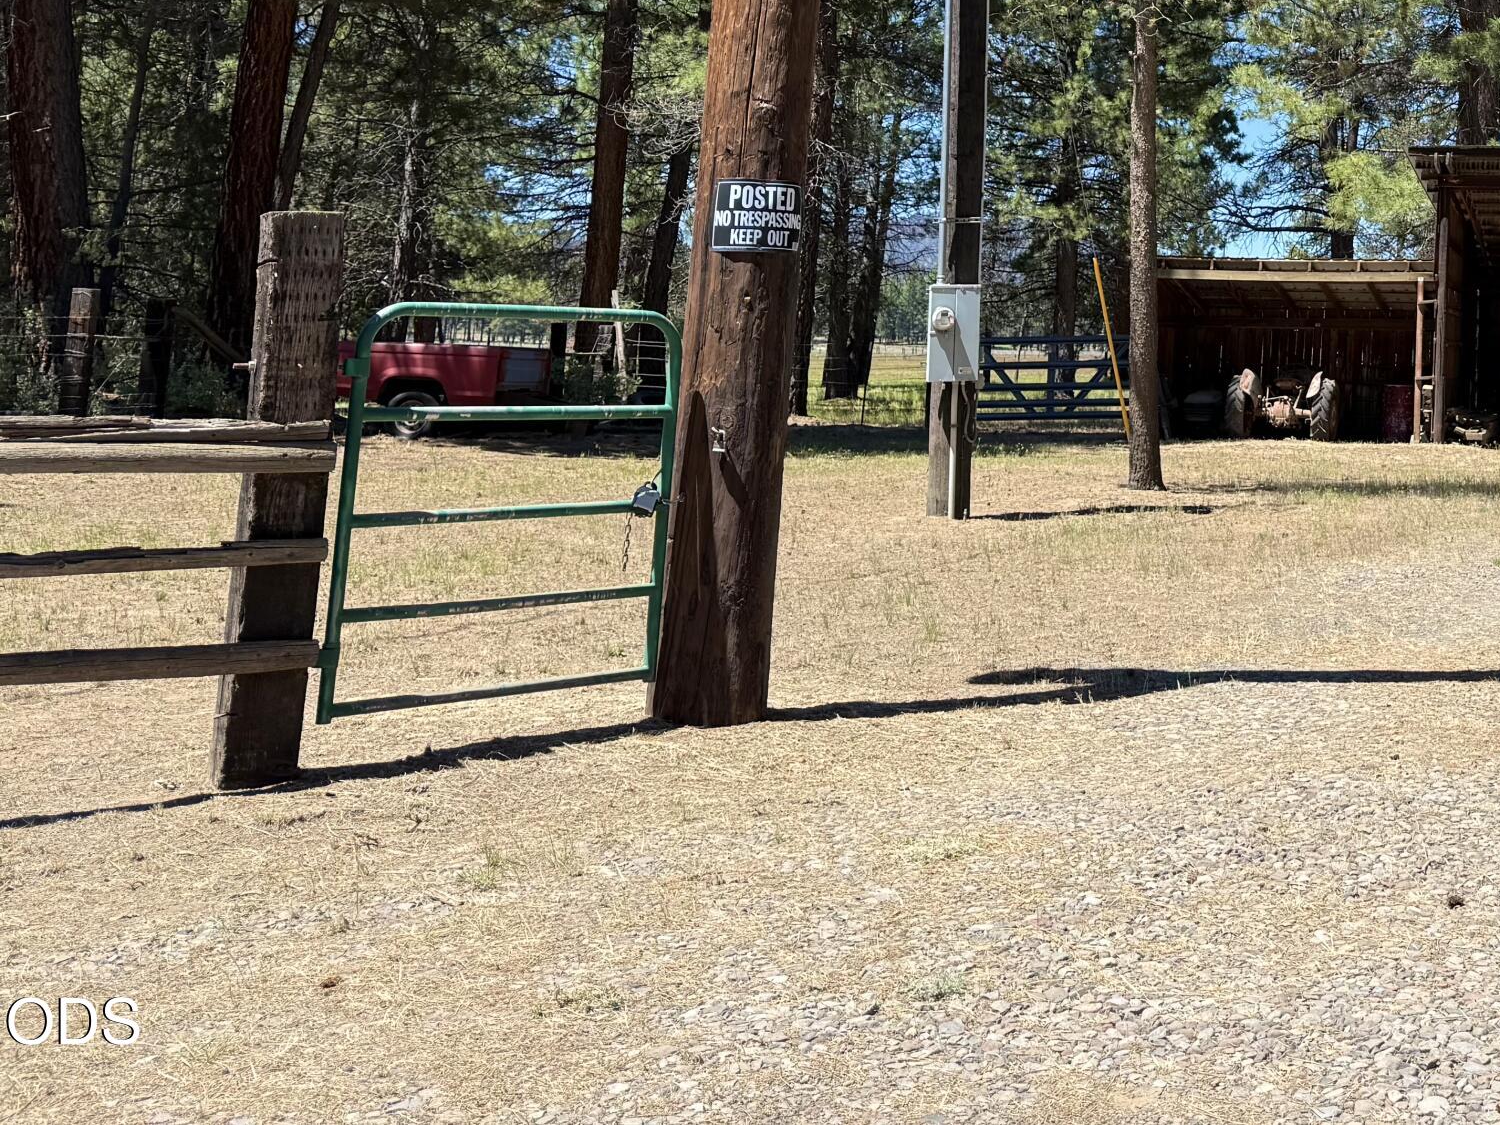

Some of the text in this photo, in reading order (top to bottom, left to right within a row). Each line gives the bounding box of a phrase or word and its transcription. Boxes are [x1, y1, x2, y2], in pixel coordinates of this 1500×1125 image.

[729, 185, 796, 211] POSTED
[714, 210, 801, 229] NO TRESPASSING
[730, 229, 790, 247] KEEP OUT
